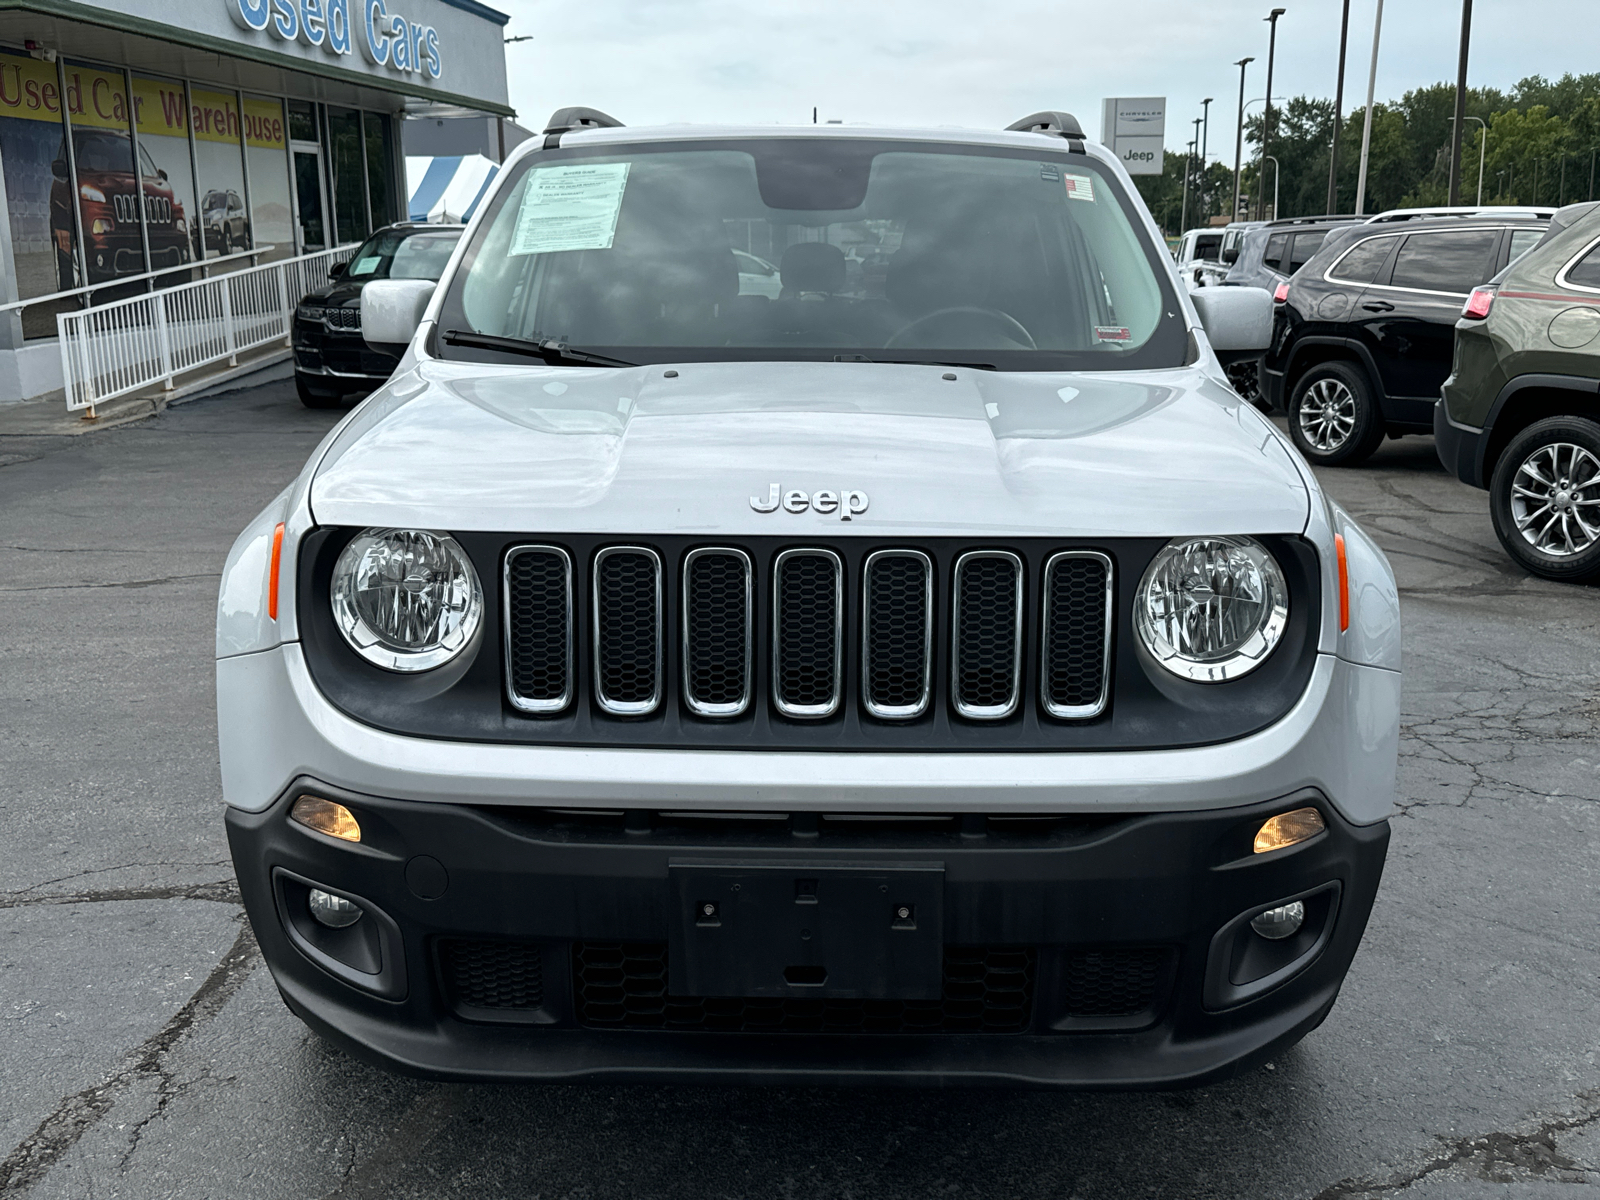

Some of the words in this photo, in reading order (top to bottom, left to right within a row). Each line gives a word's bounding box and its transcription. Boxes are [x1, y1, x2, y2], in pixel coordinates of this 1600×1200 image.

[364, 0, 442, 79] Cars
[0, 62, 86, 115] Used
[92, 77, 143, 125] Car
[159, 90, 283, 143] Warehouse
[1123, 149, 1154, 163] Jeep
[749, 483, 869, 521] Jeep
